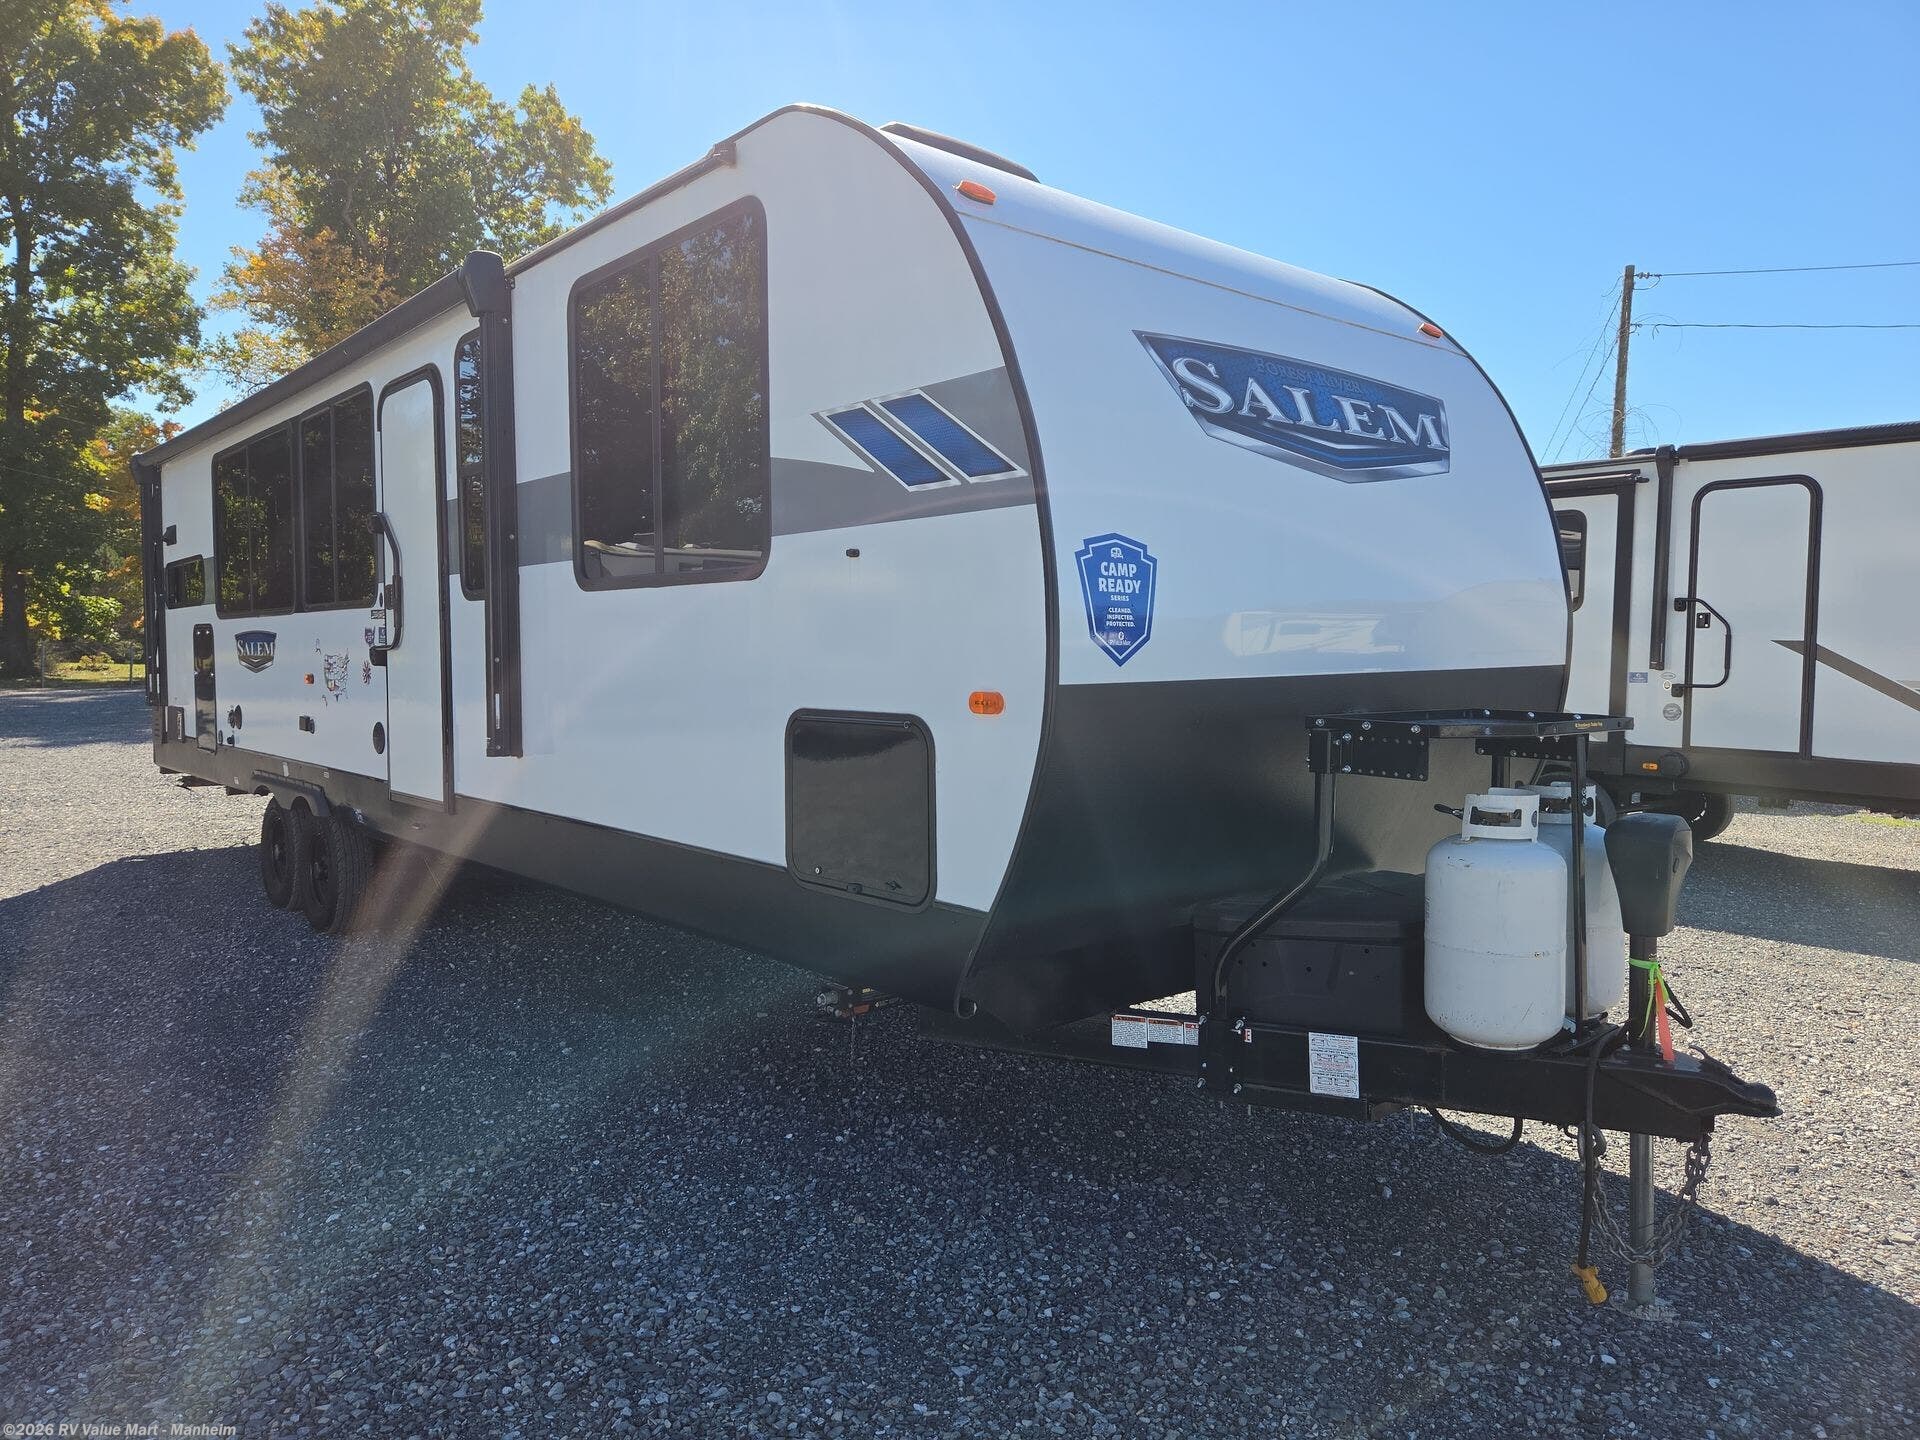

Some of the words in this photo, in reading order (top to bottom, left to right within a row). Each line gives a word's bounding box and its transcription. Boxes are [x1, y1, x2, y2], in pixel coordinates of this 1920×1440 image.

[1173, 357, 1450, 452] SALEM
[1101, 562, 1137, 577] CAMP
[1098, 578, 1141, 593] READY
[237, 640, 274, 656] SALEM
